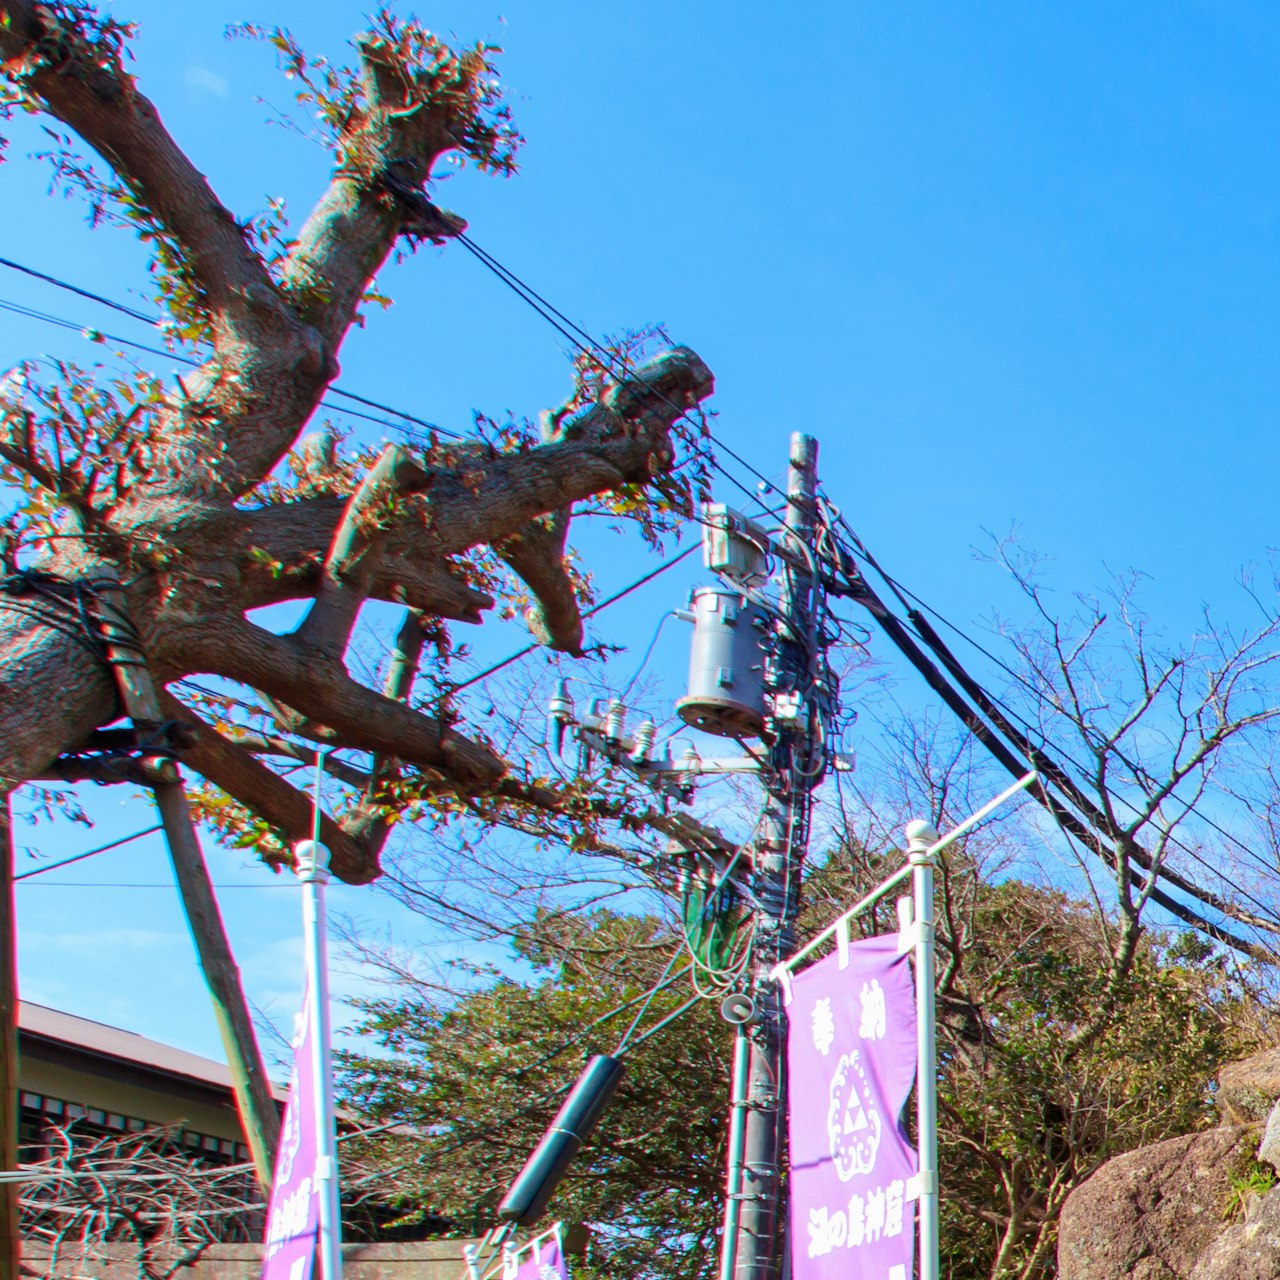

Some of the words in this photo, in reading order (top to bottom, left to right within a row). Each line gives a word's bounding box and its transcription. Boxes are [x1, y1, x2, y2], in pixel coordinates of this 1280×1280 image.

[807, 1179, 905, 1259] 江の島神窟
